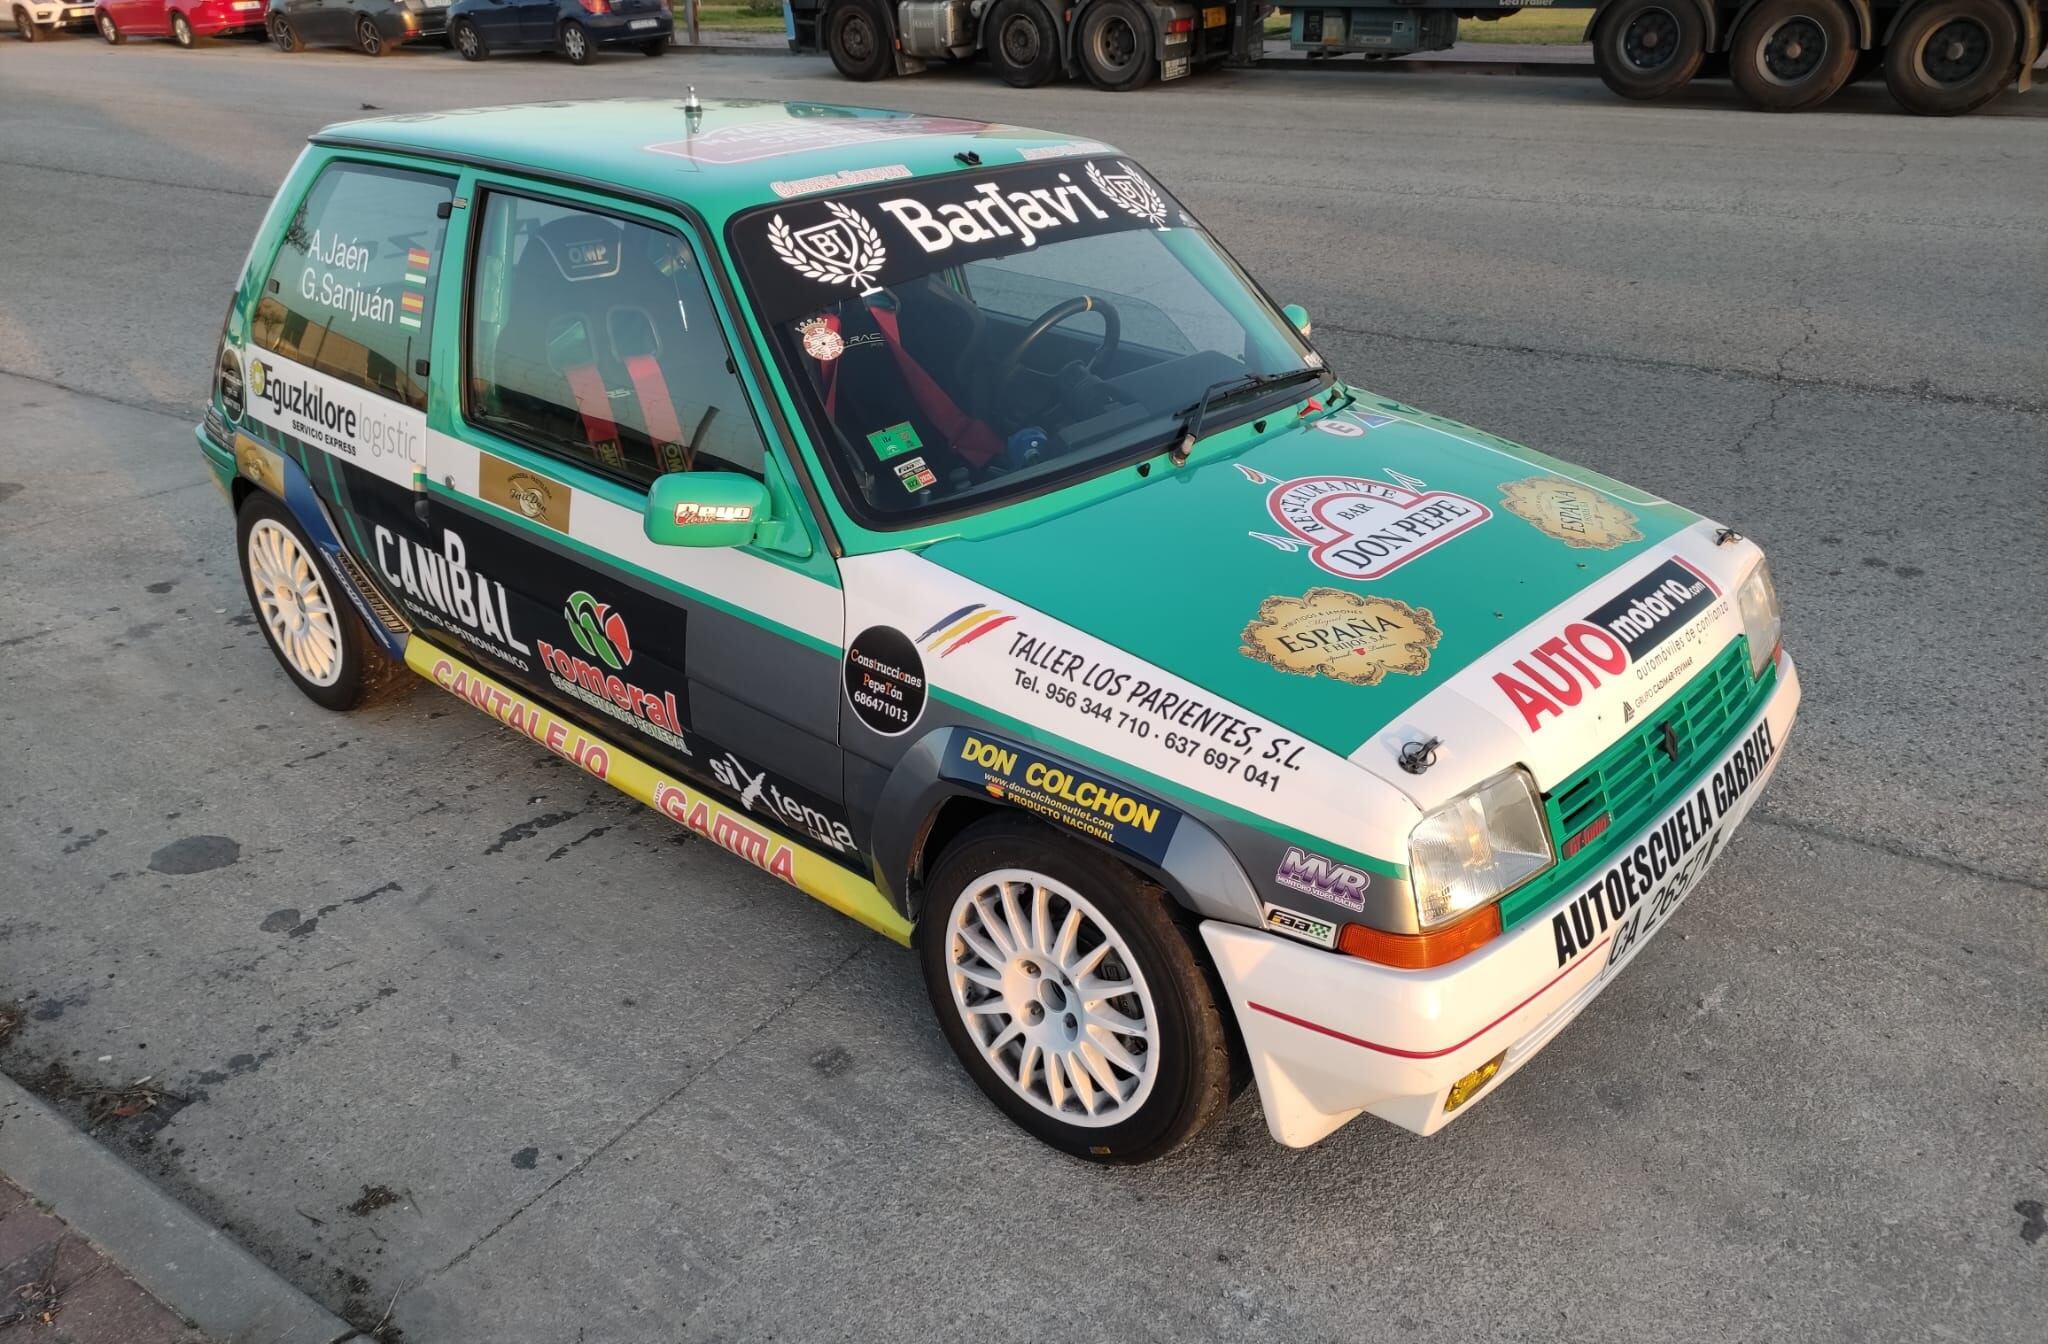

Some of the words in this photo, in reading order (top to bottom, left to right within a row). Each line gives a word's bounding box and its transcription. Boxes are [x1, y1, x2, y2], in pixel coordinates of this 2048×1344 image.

[879, 173, 1109, 252] BarJavi
[307, 229, 369, 273] A.Jaén
[808, 229, 851, 258] BJ
[302, 267, 394, 324] G.Sanjuán
[262, 361, 356, 438] Eguzkilore
[358, 402, 417, 463] logistic
[292, 419, 323, 442] SERVICIO
[324, 434, 356, 456] EXPRESS
[1281, 481, 1397, 533] RESTAURANTE
[1331, 528, 1412, 569] DON
[1398, 499, 1471, 538] PEPE
[1336, 503, 1374, 520] BAR
[1276, 615, 1403, 653] ESPAÑA
[537, 639, 684, 737] romeral
[850, 648, 922, 688] Construcciones
[1492, 623, 1627, 733] AUTO
[432, 659, 609, 781] CANTALEJO
[854, 690, 908, 723] 686471013
[1009, 631, 1084, 682] TALLER
[1082, 663, 1132, 696] LOS
[1127, 681, 1262, 755] PARIENTES,
[1262, 738, 1305, 771] S.L.
[1014, 668, 1040, 694] Tel.
[1045, 682, 1077, 708] 956
[1080, 697, 1113, 723] 344
[1117, 711, 1150, 738] 710
[1164, 732, 1200, 757] 637
[1203, 748, 1240, 774] 697
[1244, 764, 1280, 792] 041
[961, 736, 1018, 776] DON
[1025, 762, 1160, 833] COLCHON
[984, 772, 1115, 831] www.doncolchonoutlet.com
[1008, 792, 1060, 820] PRODUCTO
[1063, 814, 1115, 843] NACIONAL
[1552, 788, 1713, 968] AUTOESCUELA
[1712, 715, 1775, 818] GABRIEL
[1280, 850, 1367, 902] MVR
[1608, 905, 1642, 966] CA
